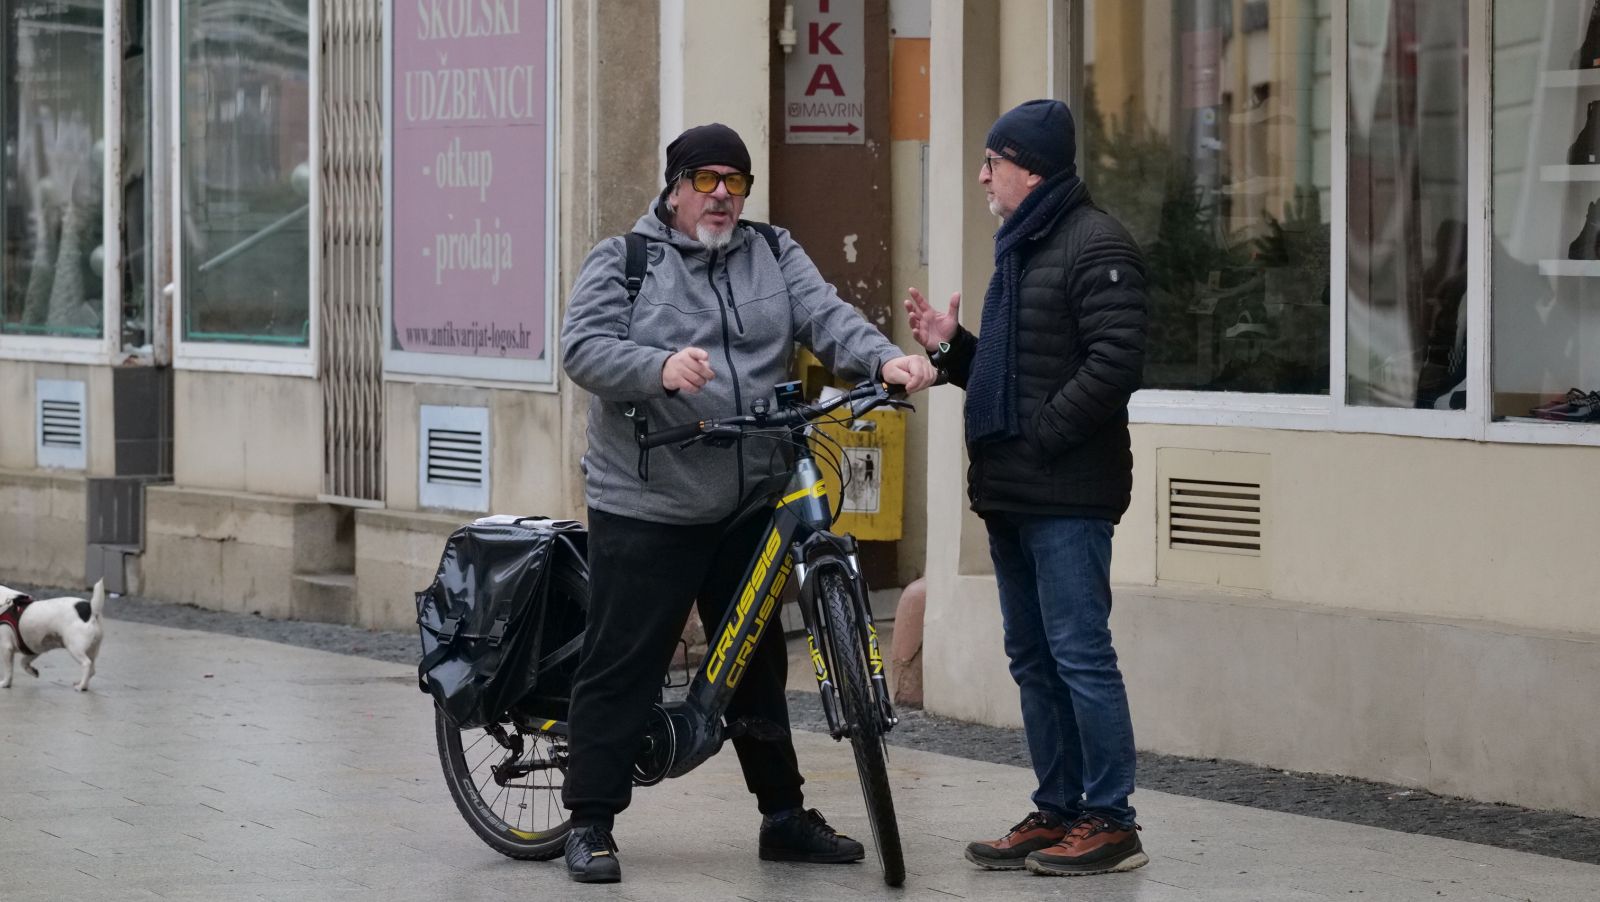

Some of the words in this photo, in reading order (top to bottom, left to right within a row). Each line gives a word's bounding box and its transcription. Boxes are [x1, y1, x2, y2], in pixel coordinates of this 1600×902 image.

[405, 51, 535, 121] UDŽBENICI
[435, 137, 493, 202] otkup
[435, 217, 513, 286] prodaja
[406, 321, 531, 356] www.antikvarijat-logos.hr
[706, 527, 782, 684] CRUSSIS
